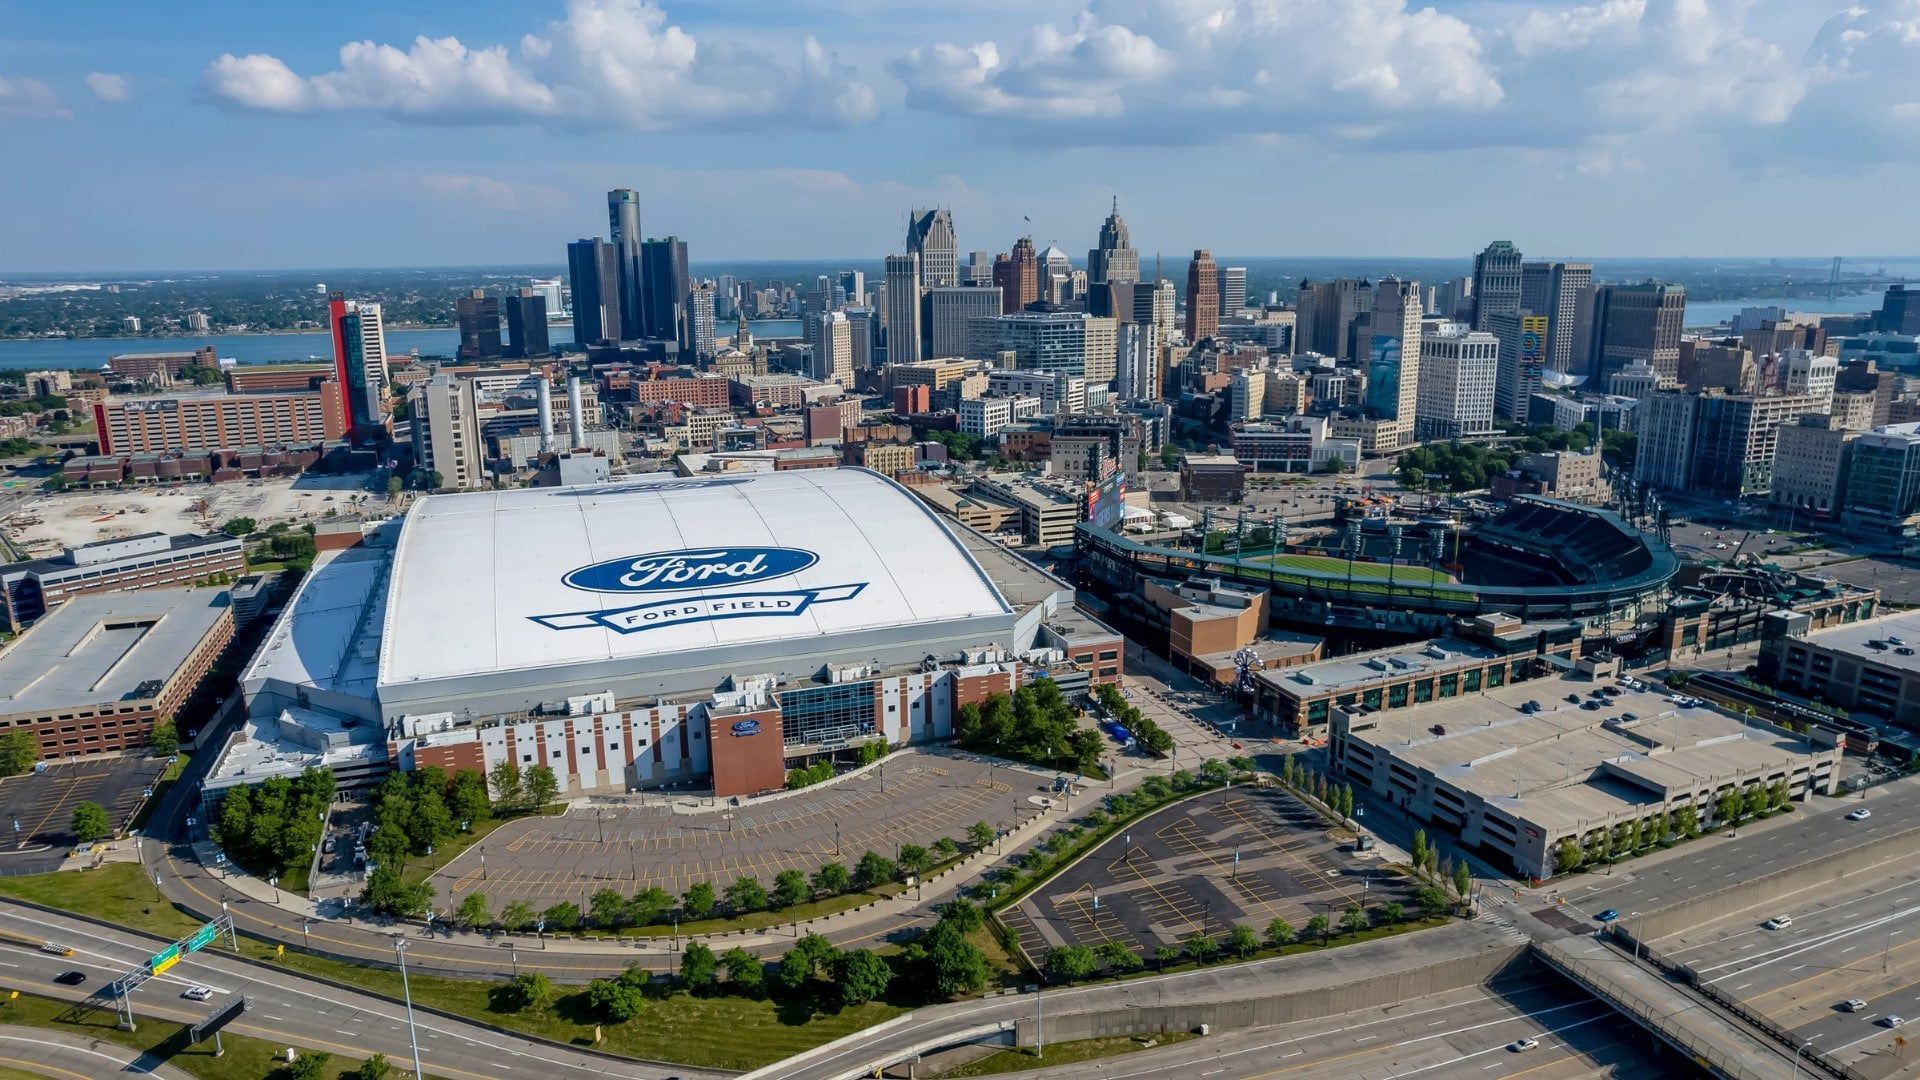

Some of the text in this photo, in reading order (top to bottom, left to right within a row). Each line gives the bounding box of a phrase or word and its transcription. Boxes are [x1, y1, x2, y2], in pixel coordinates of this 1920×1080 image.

[619, 551, 768, 587] Ford
[626, 600, 792, 625] FORD FIELD
